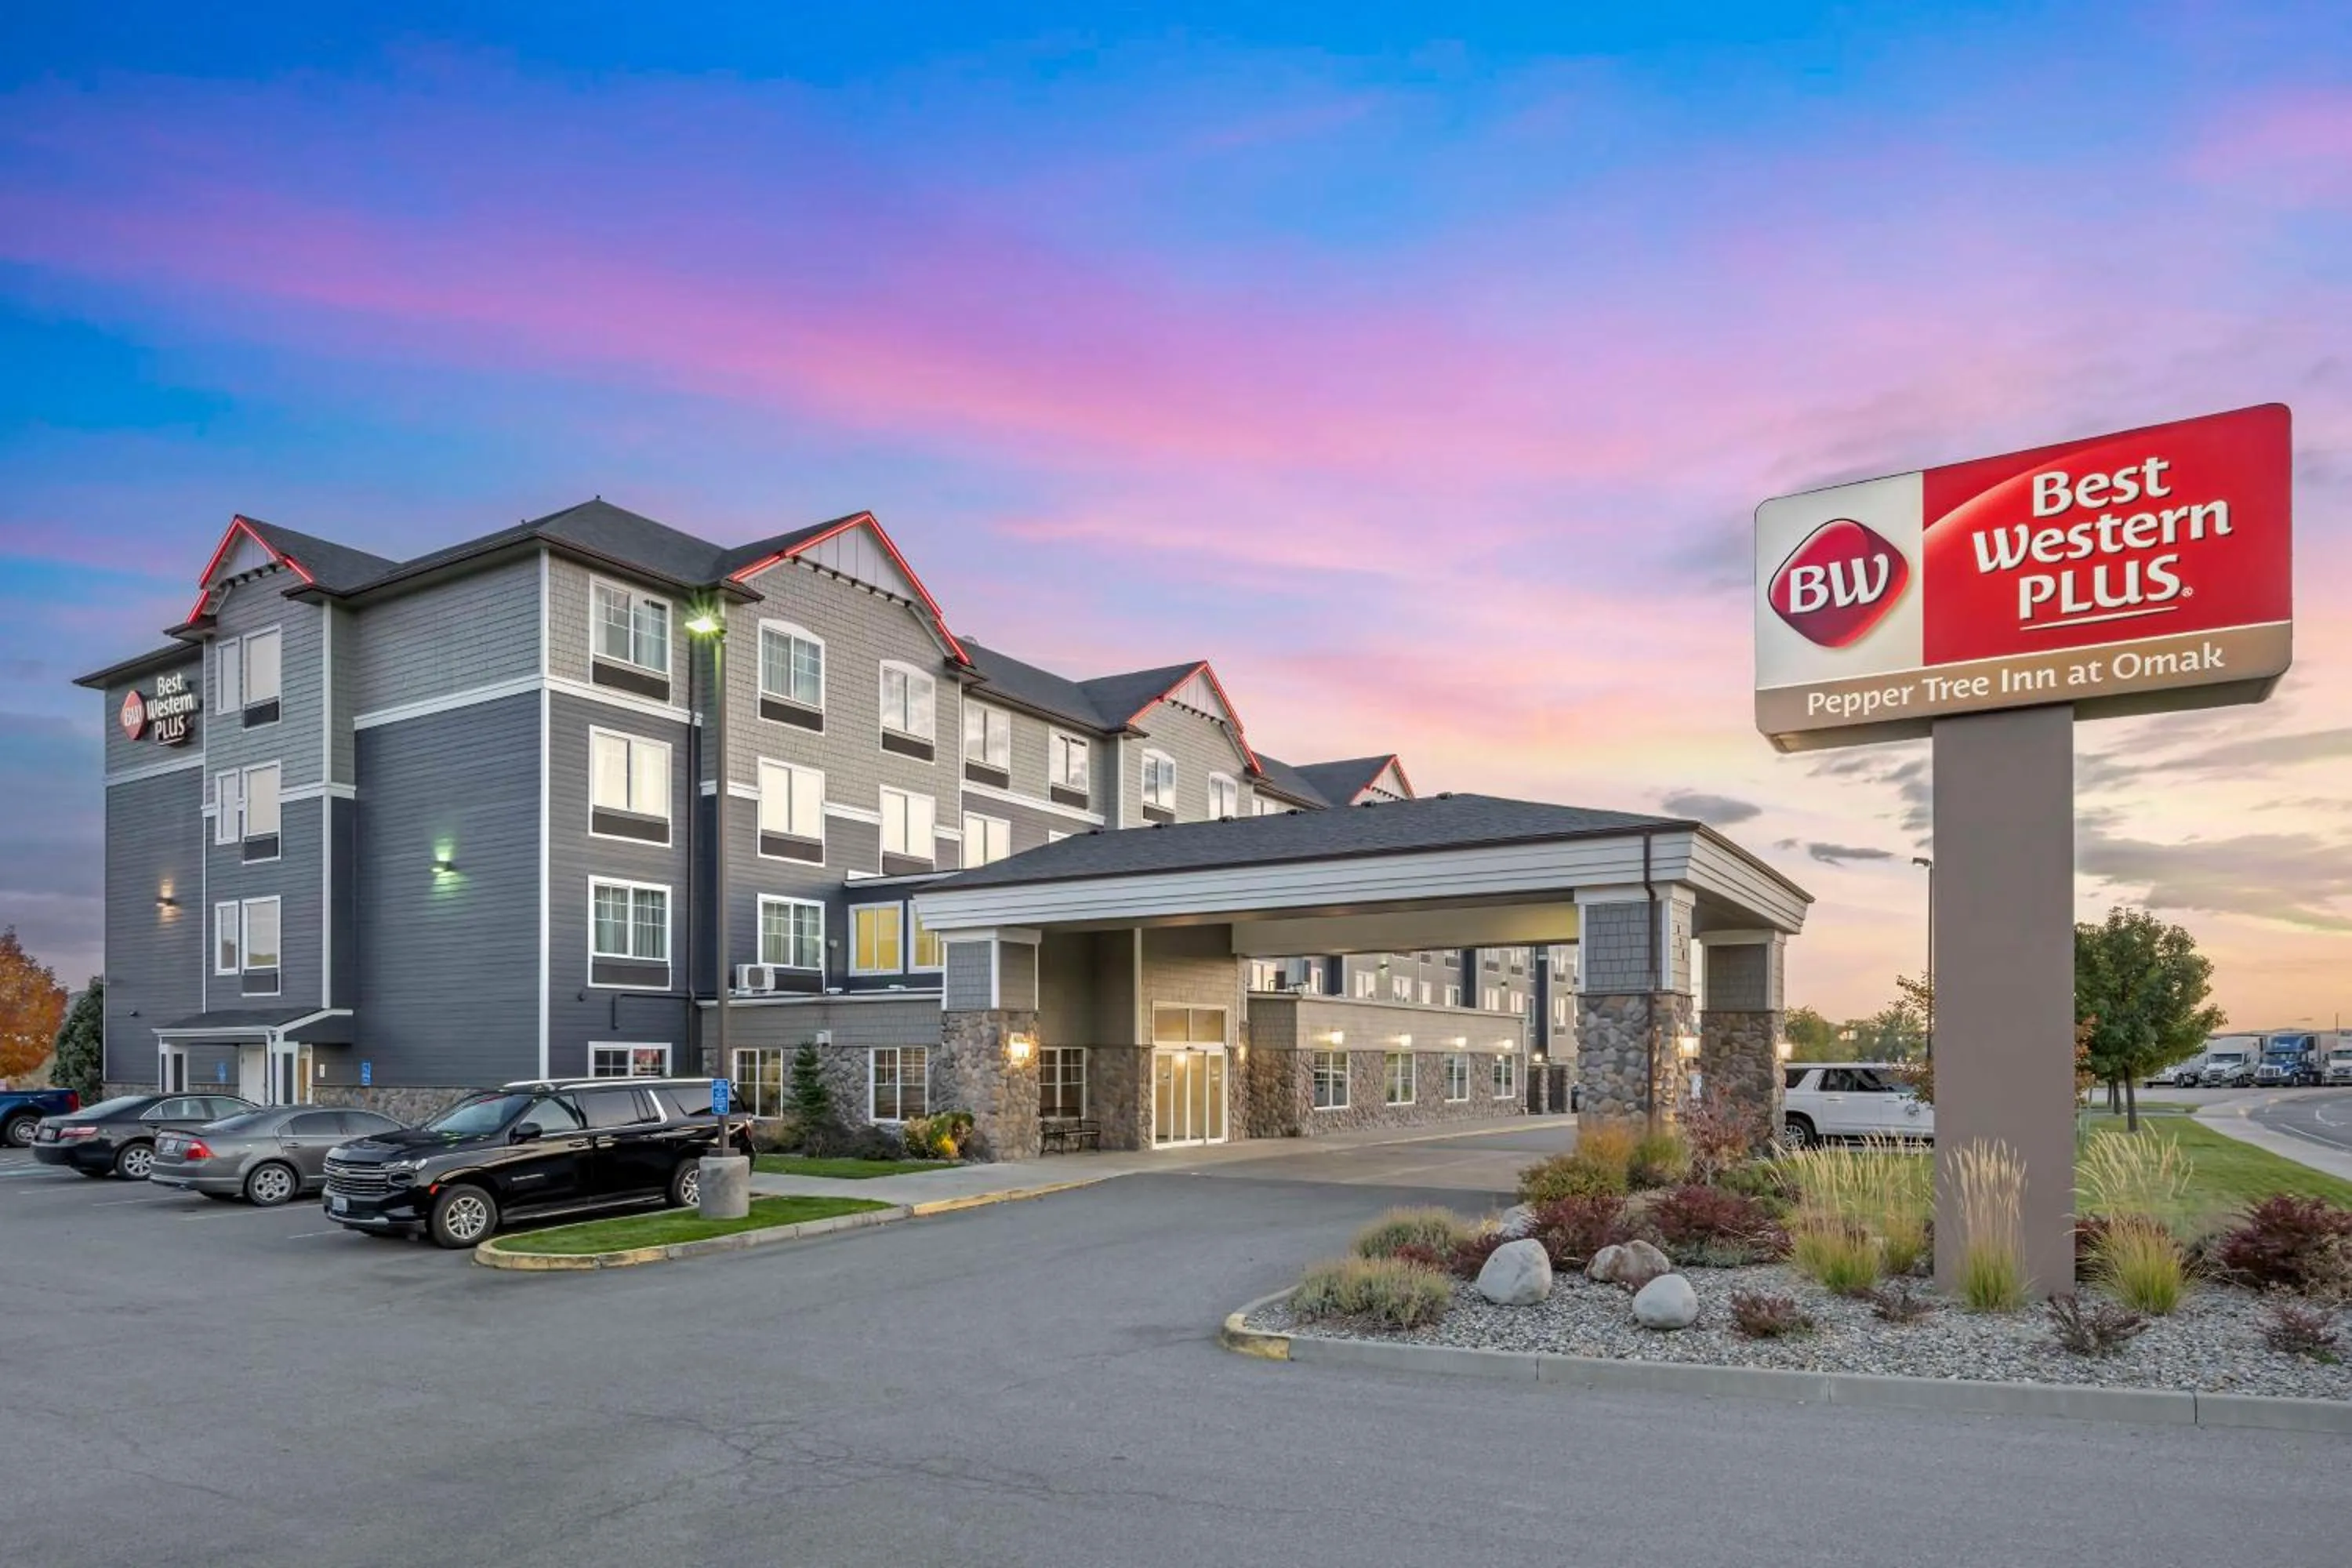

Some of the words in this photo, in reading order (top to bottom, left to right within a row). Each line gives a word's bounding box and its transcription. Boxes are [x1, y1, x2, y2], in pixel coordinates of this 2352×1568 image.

[2033, 457, 2171, 517] Best
[1972, 499, 2233, 574] Western
[1790, 553, 1889, 614] BW
[147, 693, 193, 720] Western
[158, 673, 183, 696] Best
[1807, 685, 1915, 717] Pepper
[1922, 676, 1990, 702] Tree
[2001, 668, 2057, 692] Inn
[2067, 660, 2103, 685] at
[2112, 641, 2226, 680] Omak
[155, 715, 185, 740] PLUS
